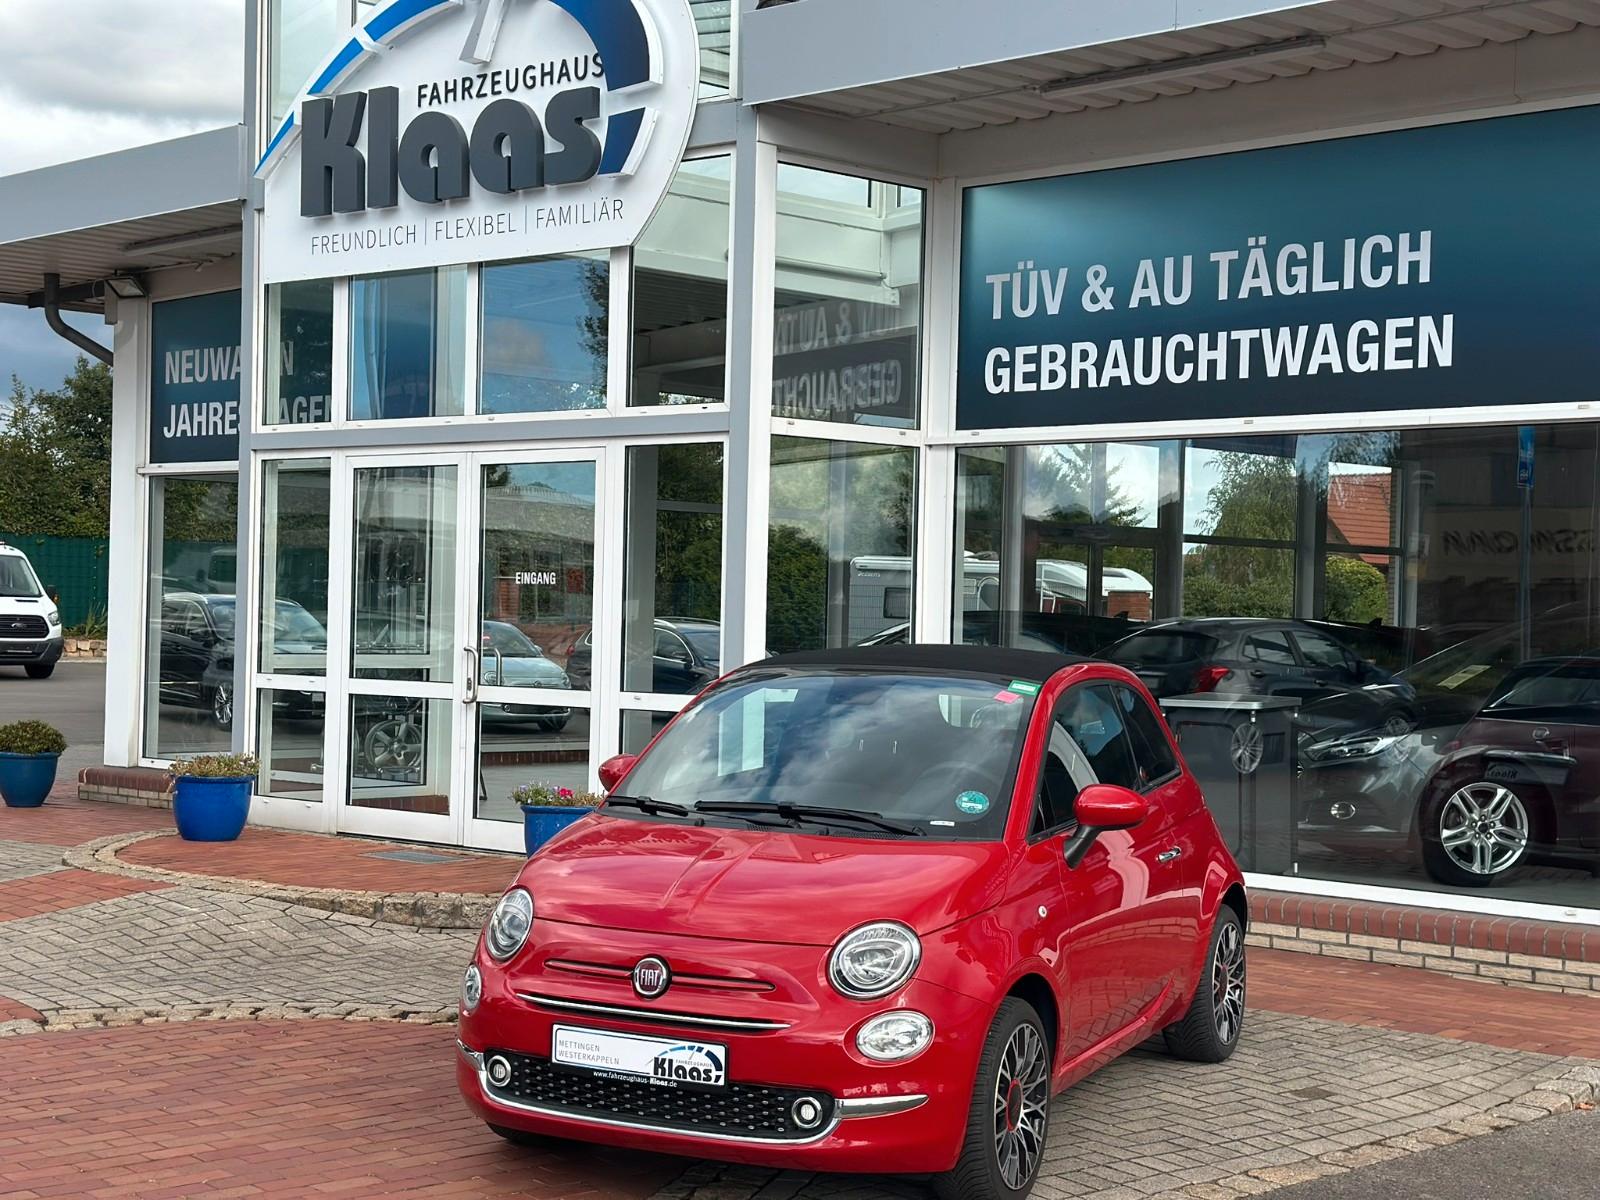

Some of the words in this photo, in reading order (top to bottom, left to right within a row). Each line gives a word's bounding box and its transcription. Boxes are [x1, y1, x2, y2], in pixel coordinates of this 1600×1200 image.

[417, 52, 604, 107] FAHRZEUGHAUS
[301, 86, 601, 219] Klaas
[311, 224, 417, 255] FREUNDLICH
[434, 212, 517, 241] FLEXIBEL
[536, 199, 624, 229] FAMILIÄR
[985, 260, 1068, 320] TÜV
[1081, 264, 1114, 313] &
[1128, 255, 1193, 308] AU
[1209, 230, 1432, 300] TÄGLICH
[984, 314, 1454, 394] GEBRAUCHTWAGEN
[515, 571, 556, 585] EINGANG
[640, 968, 660, 987] FIAT
[558, 1039, 600, 1052] METTINGEN
[558, 1049, 620, 1065] WESTERKAPPELN
[653, 1056, 713, 1083] Klaas
